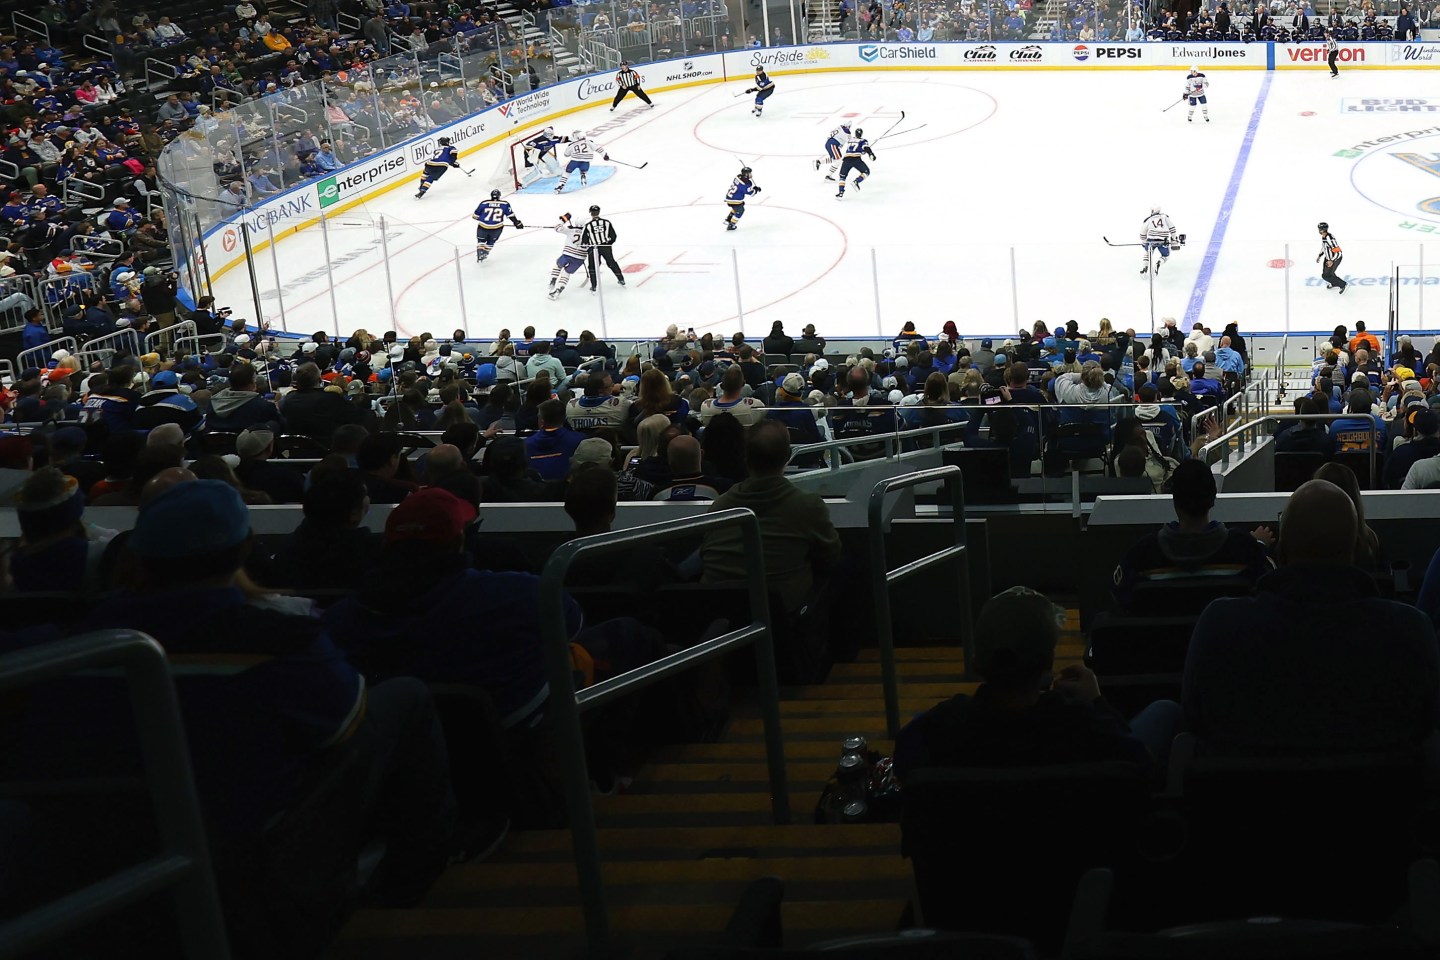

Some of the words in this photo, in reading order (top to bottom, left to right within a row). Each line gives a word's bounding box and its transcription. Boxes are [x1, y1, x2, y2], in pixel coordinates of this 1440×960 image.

[750, 49, 804, 67] Surfside
[879, 46, 936, 59] CarShield
[964, 48, 997, 59] Club
[1009, 48, 1042, 59] Club
[1096, 47, 1142, 59] PEPSI
[1172, 46, 1212, 58] Edward
[1212, 47, 1246, 59] Jones
[1287, 44, 1365, 62] verion
[577, 78, 613, 100] Circa
[516, 96, 533, 107] World
[533, 91, 550, 102] Wide
[516, 98, 550, 115] Technology
[415, 142, 434, 161] BJC
[318, 154, 405, 199] enterprise
[269, 192, 312, 222] BANK
[483, 208, 503, 222] 72
[593, 225, 605, 234] 55
[572, 417, 609, 429] THOMAS
